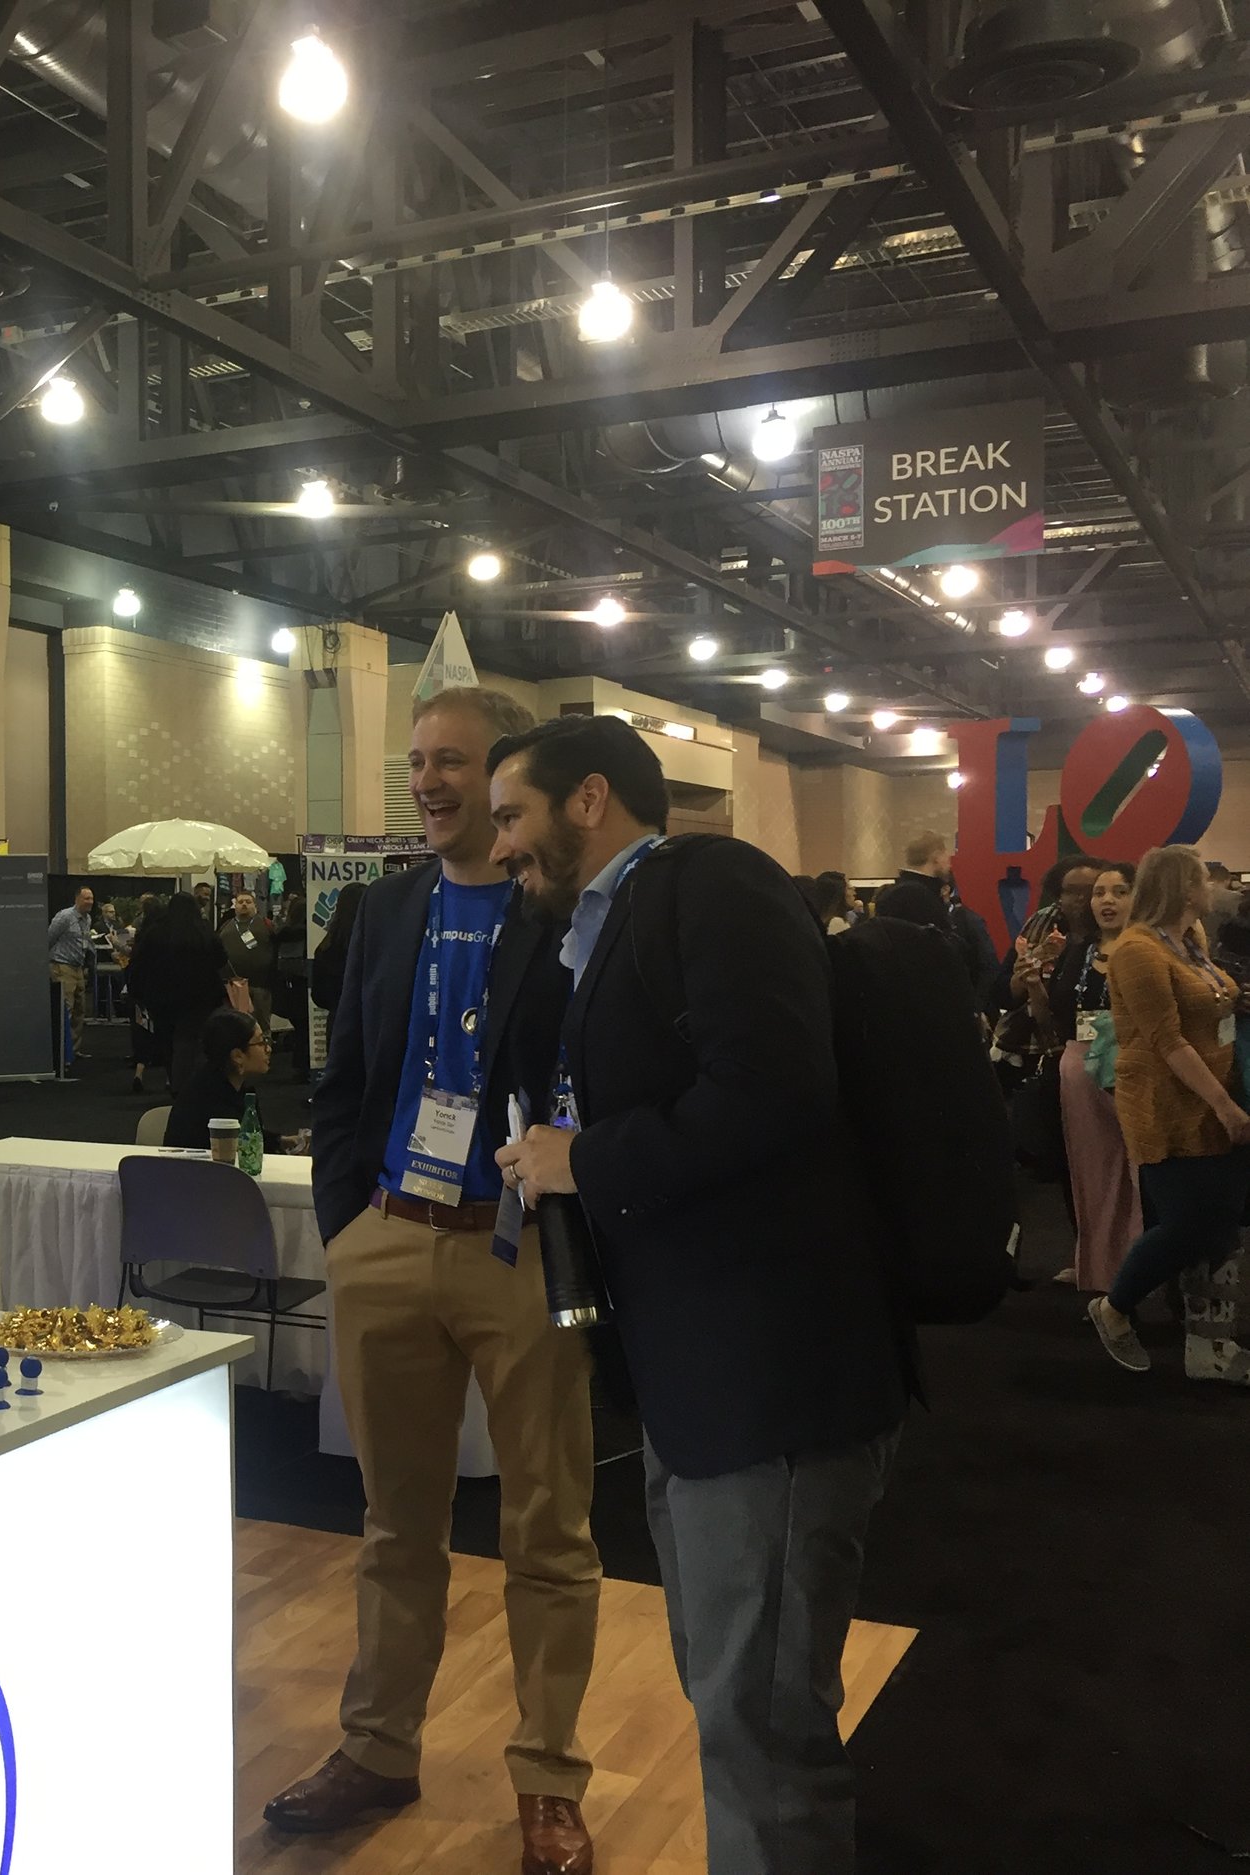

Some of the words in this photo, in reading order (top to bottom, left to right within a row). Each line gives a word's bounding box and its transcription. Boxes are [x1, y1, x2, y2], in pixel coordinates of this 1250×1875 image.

[821, 447, 861, 459] NASPA
[892, 440, 1011, 480] BREAK
[874, 481, 1027, 523] STATION
[445, 664, 473, 684] NASPA
[311, 860, 380, 881] NASPA
[411, 1160, 459, 1180] EXHIBITOR
